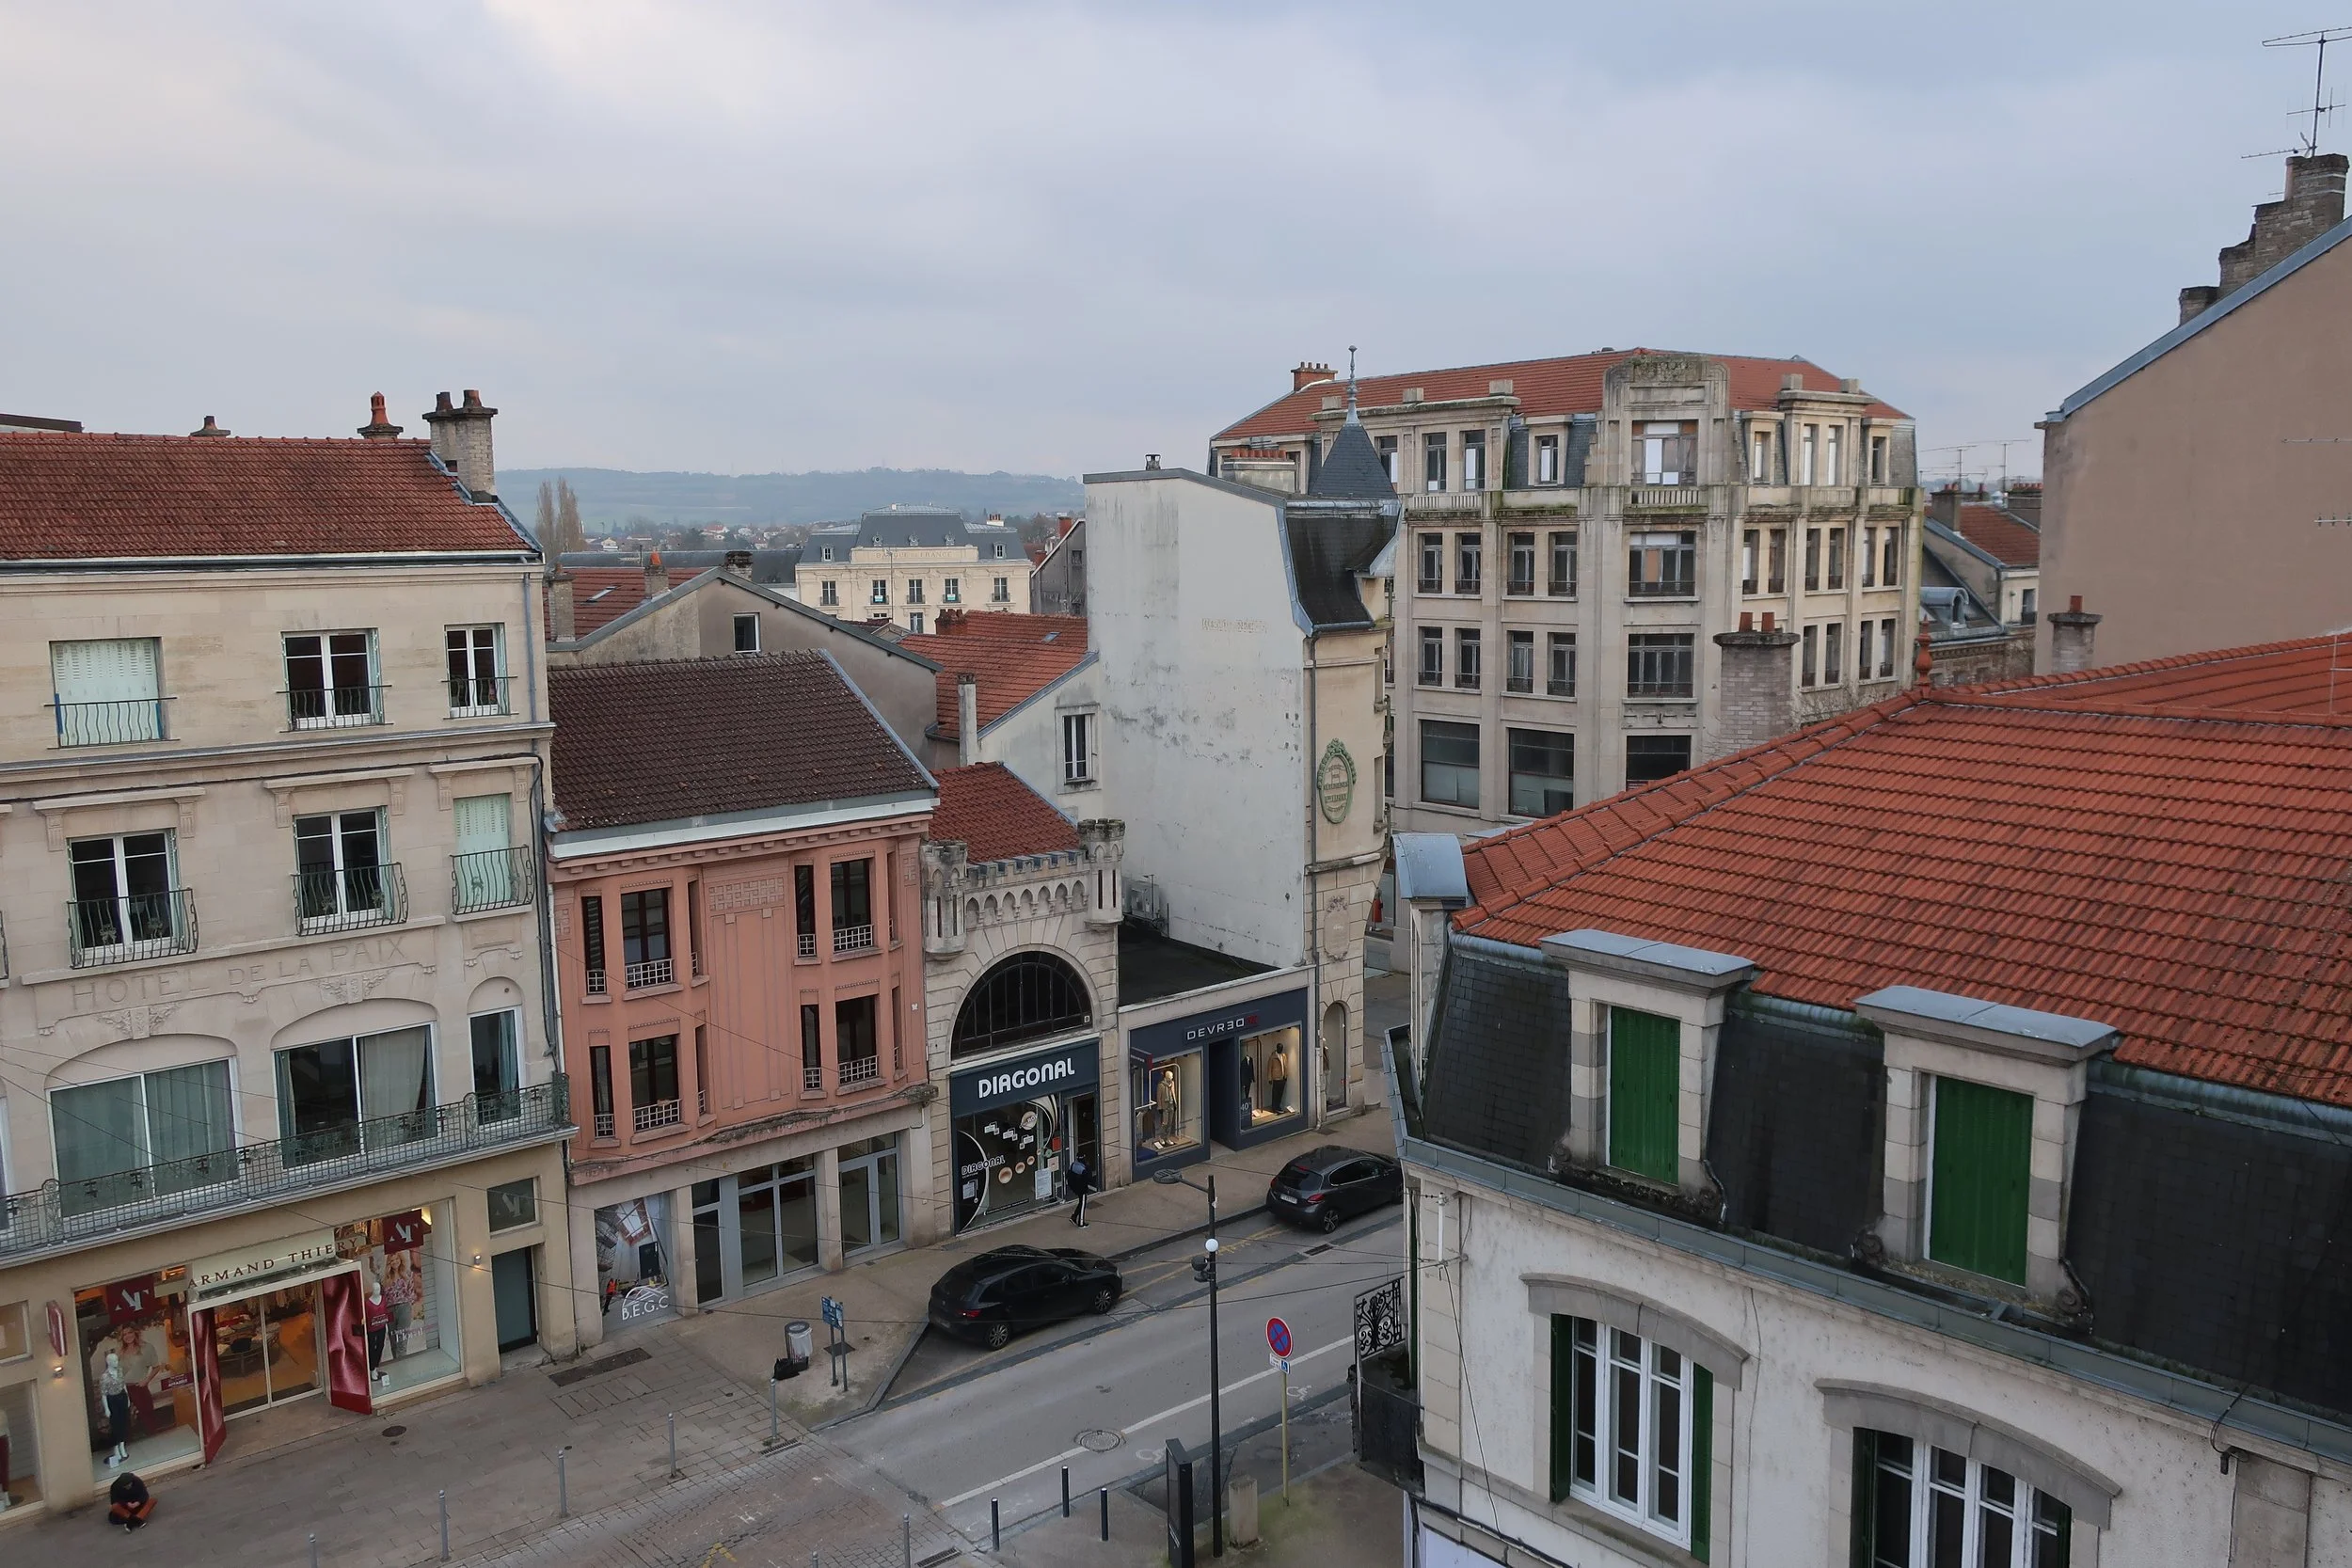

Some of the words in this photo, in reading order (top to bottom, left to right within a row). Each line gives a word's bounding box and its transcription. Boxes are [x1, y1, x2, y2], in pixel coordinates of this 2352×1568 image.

[72, 971, 210, 1010] HOTEL
[228, 964, 266, 986] DE
[278, 958, 313, 978] LA
[330, 936, 406, 971] PAIX
[978, 1057, 1075, 1099] DIAGONAL
[961, 1155, 1006, 1176] DIAGONAL
[188, 1259, 275, 1289] ARMAND
[288, 1237, 359, 1263] THIERY
